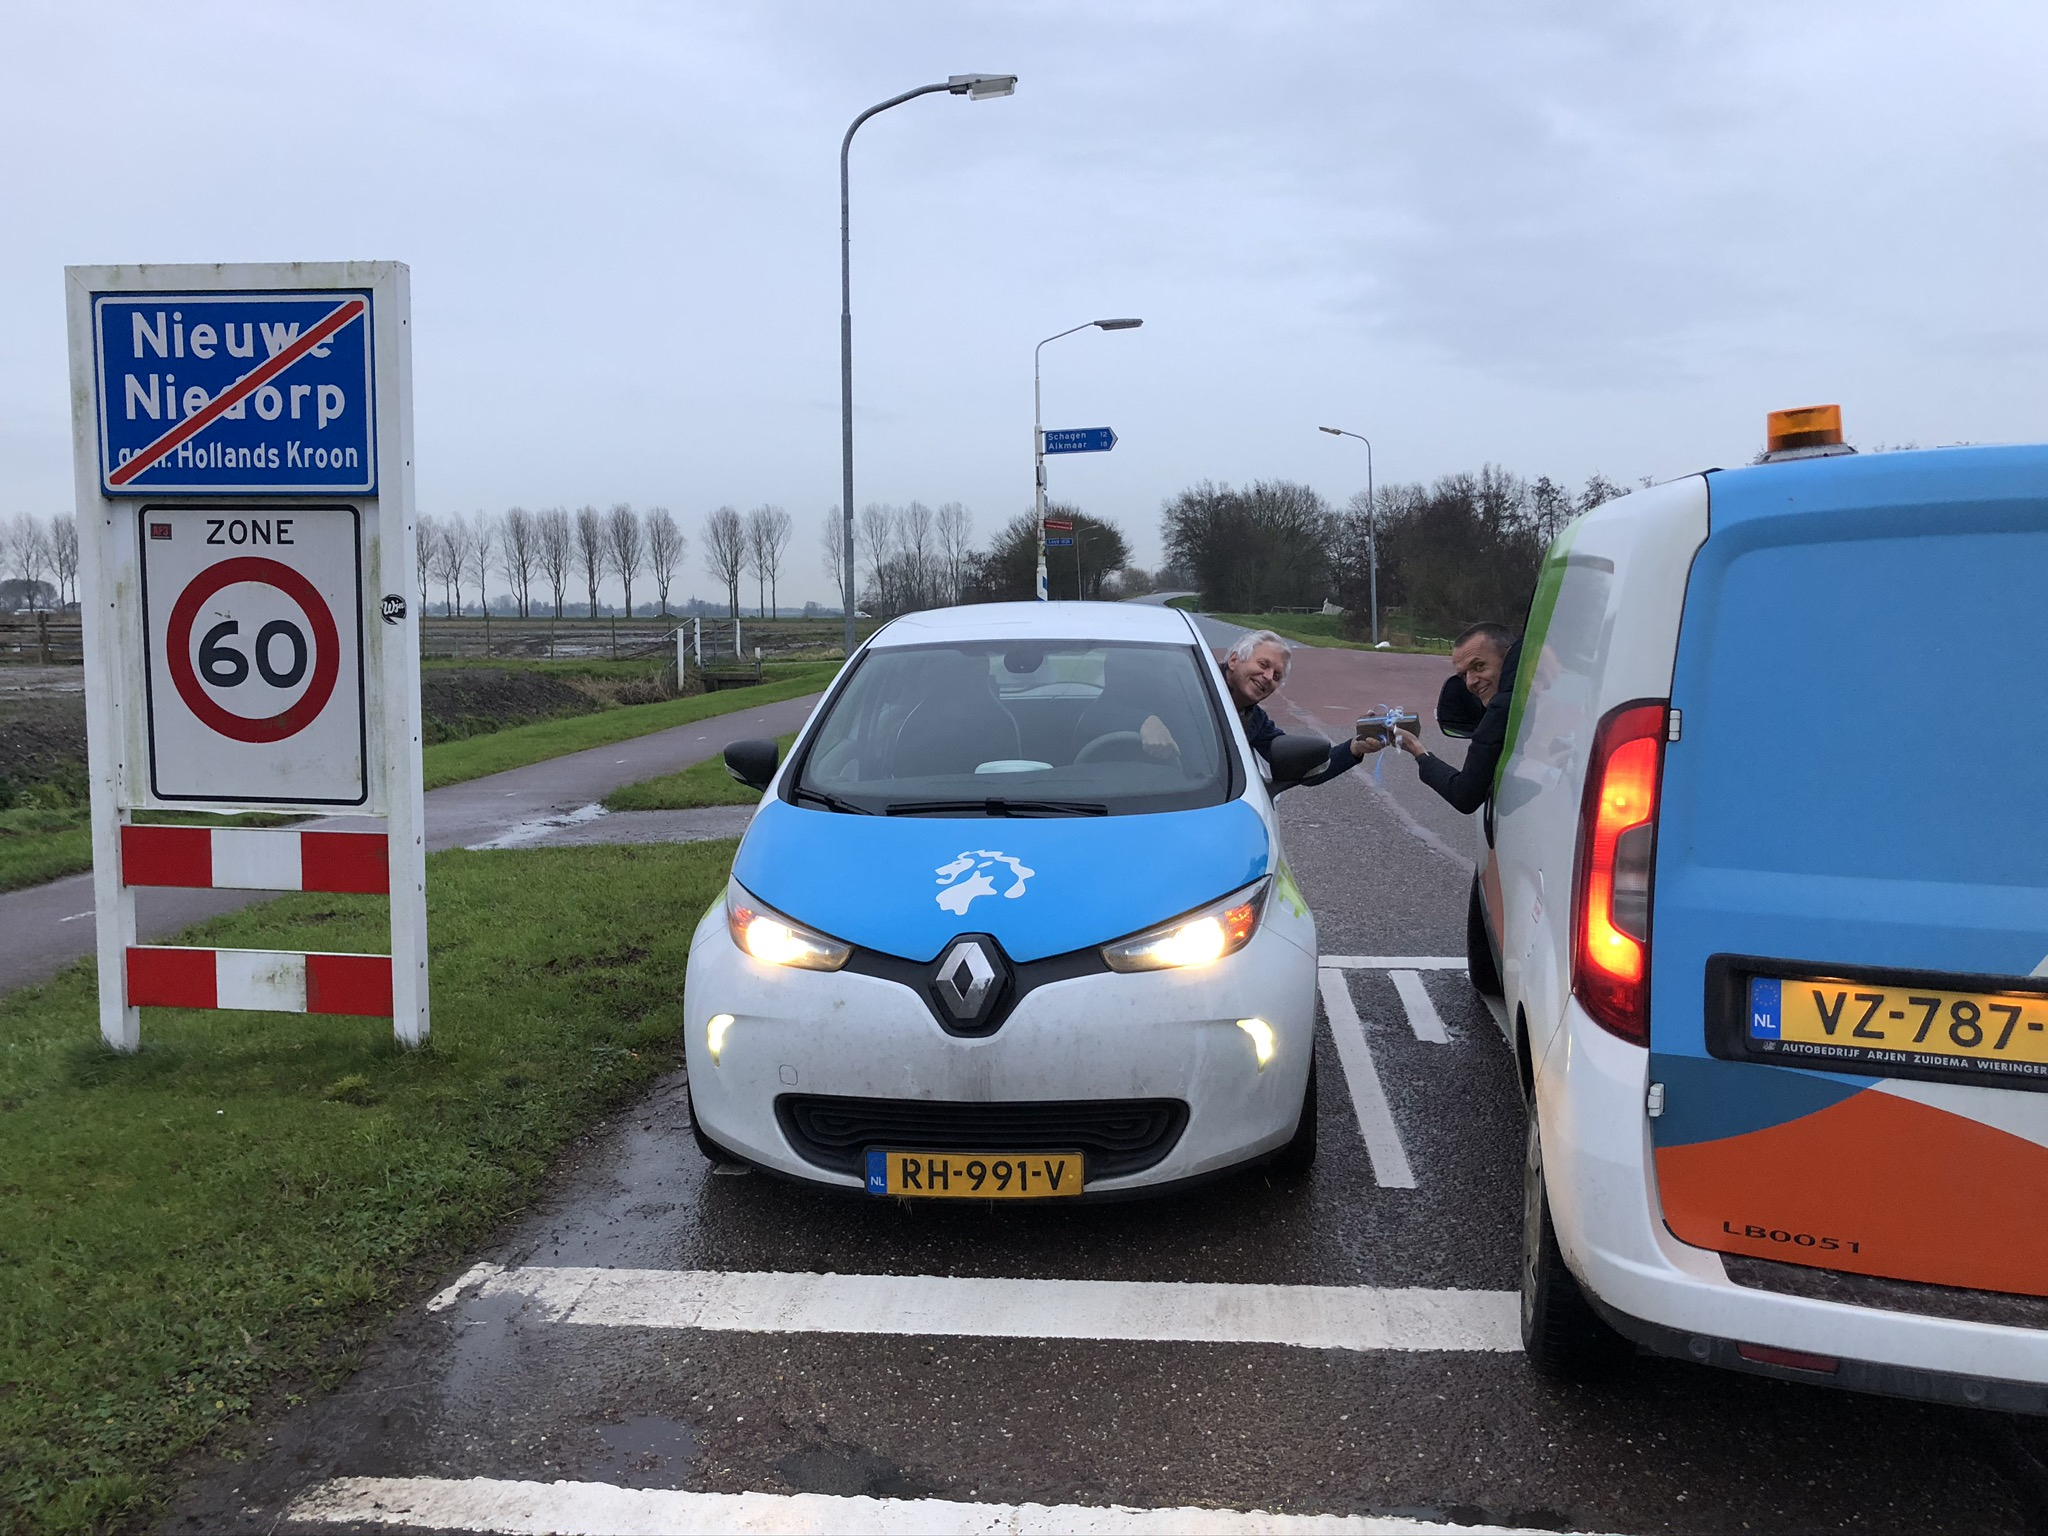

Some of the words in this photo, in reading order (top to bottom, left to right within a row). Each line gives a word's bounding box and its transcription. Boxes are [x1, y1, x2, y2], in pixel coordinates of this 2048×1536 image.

[1048, 432, 1087, 442] Schagen
[1048, 441, 1087, 450] Alkmaar
[118, 447, 172, 469] g.
[177, 441, 280, 469] Hollands
[286, 440, 359, 469] Kroon
[206, 519, 295, 545] ZONE
[198, 619, 308, 689] 60
[1754, 1013, 1776, 1029] NL
[1782, 1043, 1860, 1058] AUTOBEDRIJF
[1867, 1050, 1906, 1063] ARJEN
[1913, 1054, 1969, 1069] ZUIDEMA
[1977, 1060, 2048, 1075] WIERINGER
[870, 1176, 885, 1187] NL
[901, 1157, 1066, 1192] RH-991-V
